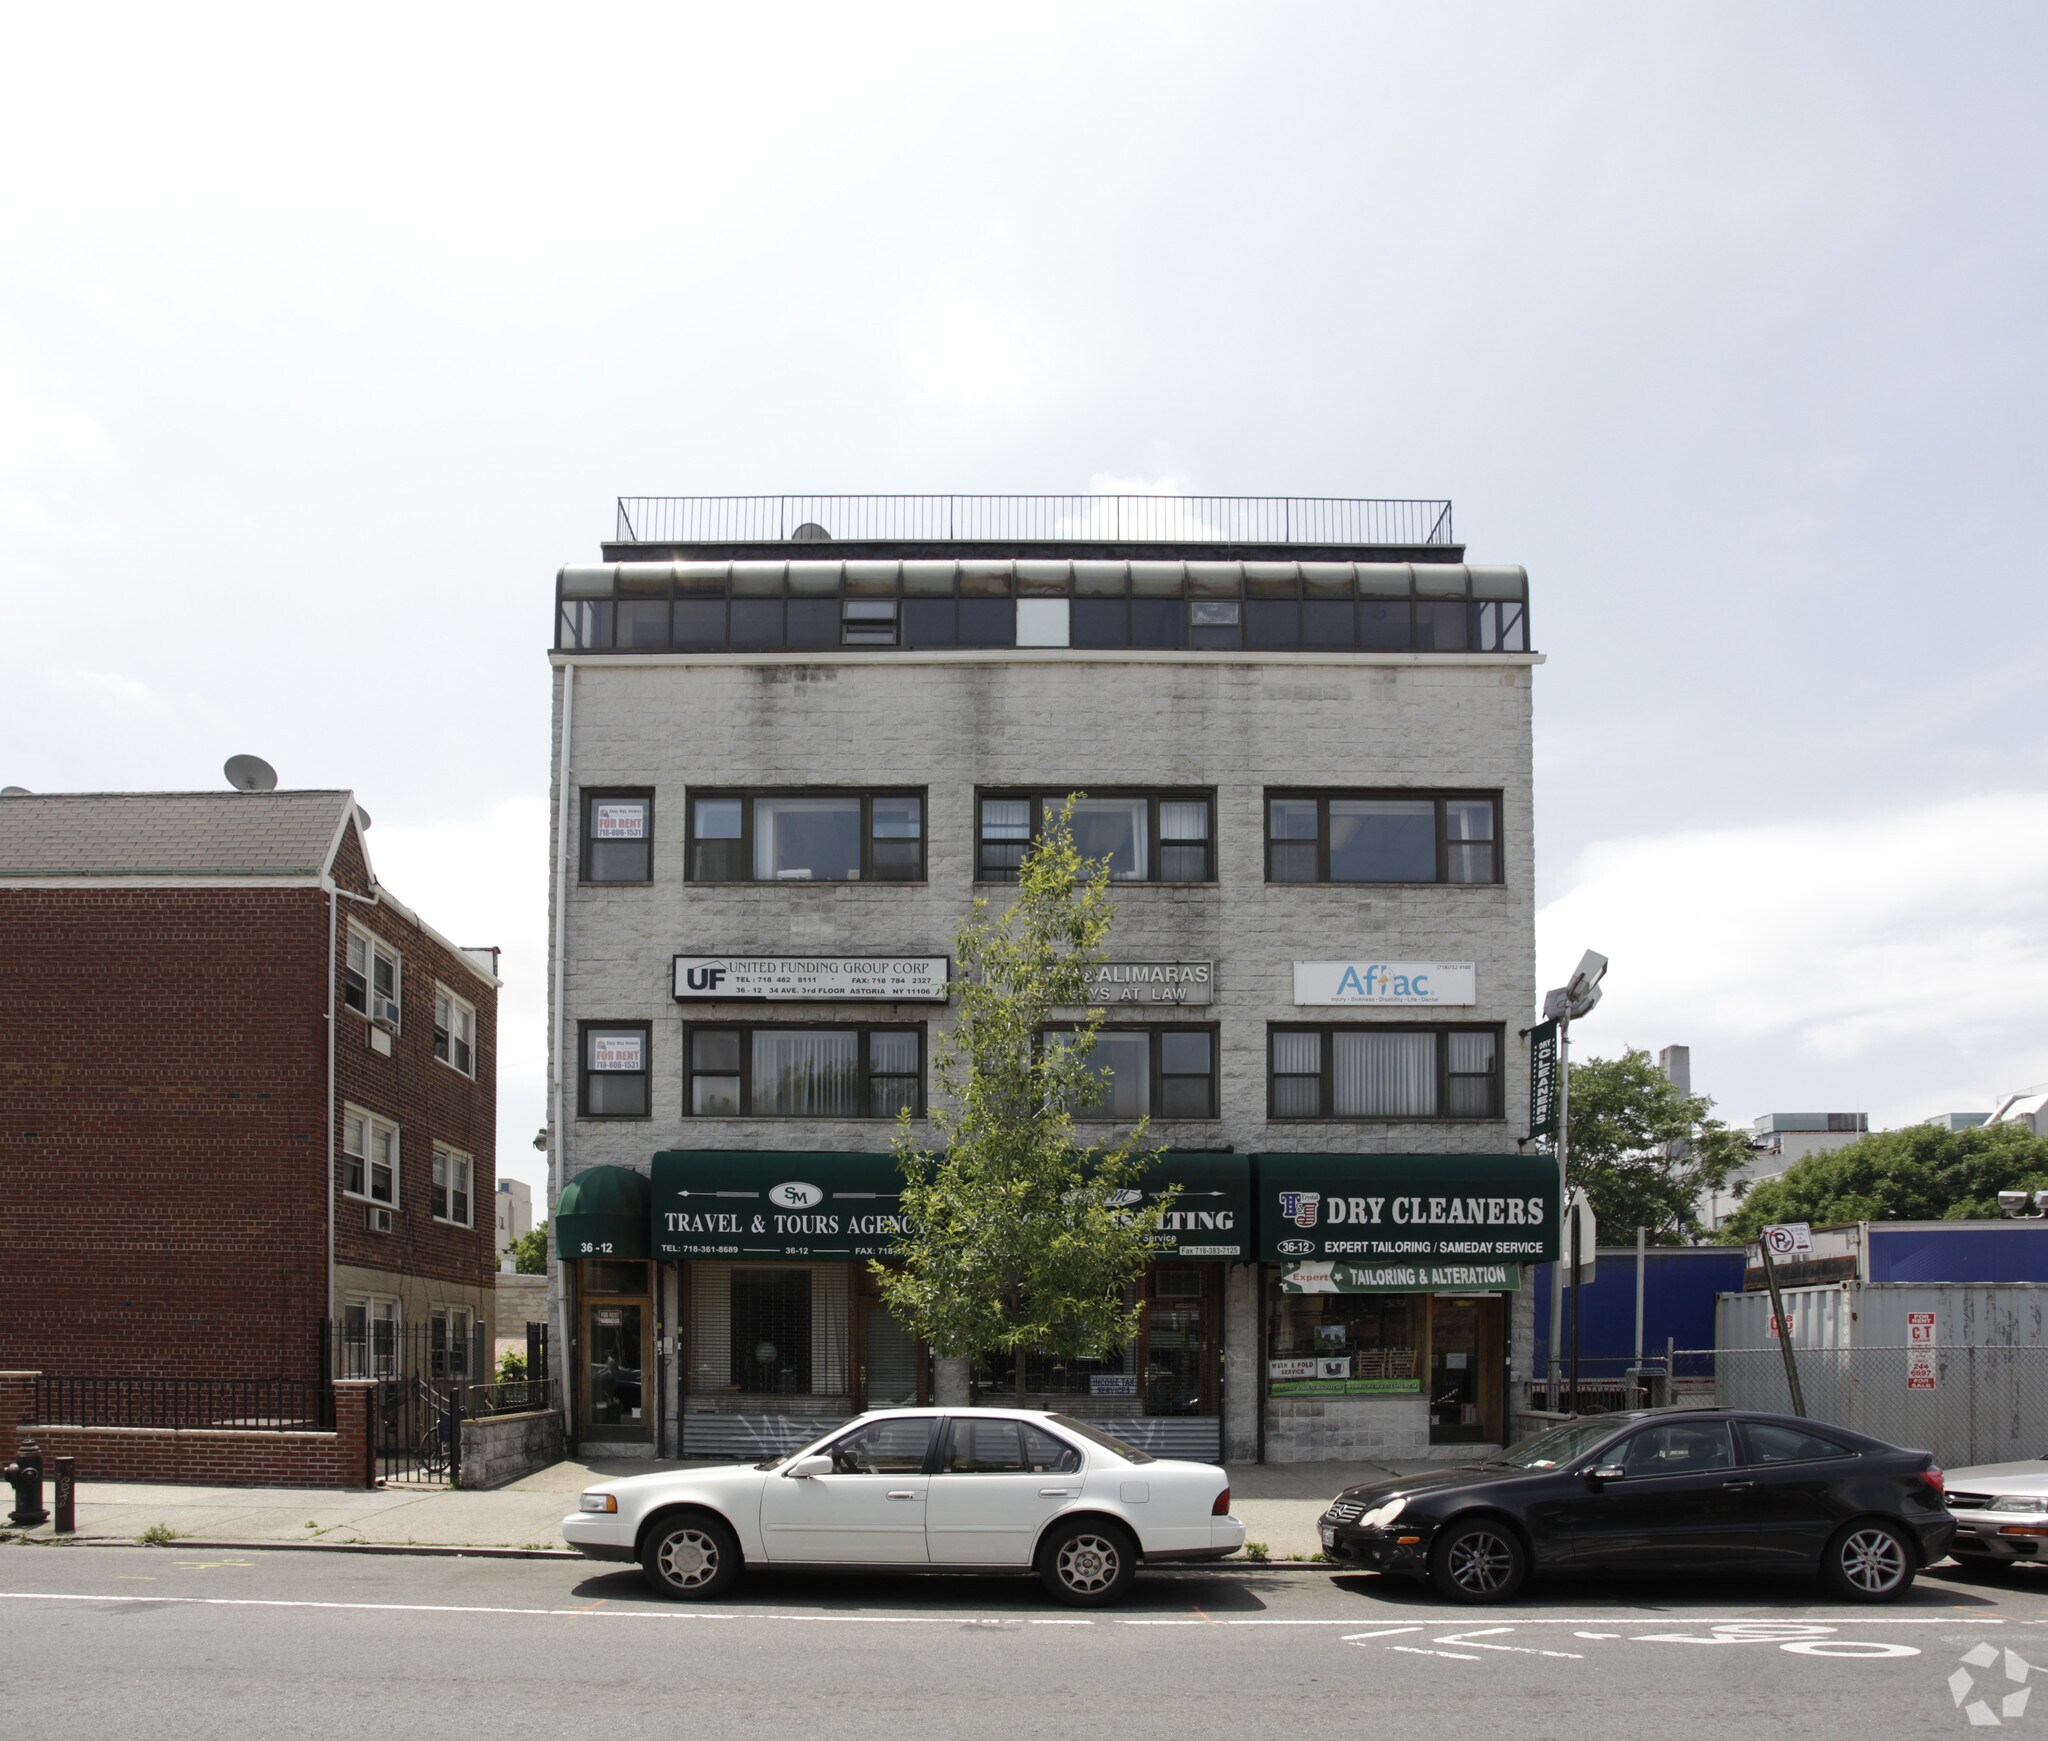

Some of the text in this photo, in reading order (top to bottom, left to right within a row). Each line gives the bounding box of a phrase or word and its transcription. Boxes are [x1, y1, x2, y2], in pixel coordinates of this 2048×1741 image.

[599, 818, 641, 828] FOR RENT
[729, 962, 929, 974] UNITED FUNDING GROUP CORP
[1099, 965, 1209, 983] ALIMARAS
[687, 968, 727, 990] UF
[1336, 964, 1429, 996] Aflac
[1121, 987, 1141, 1000] AT
[1152, 987, 1187, 1000] LAW
[1539, 1039, 1551, 1049] DRY
[597, 1051, 639, 1060] FOR RENT
[1535, 1049, 1551, 1125] CLEANERS
[1327, 1197, 1544, 1225] DRY CLEANERS
[664, 1213, 742, 1233] TRAVEL
[751, 1215, 766, 1233] &
[774, 1215, 839, 1234] TOURS
[1142, 1233, 1177, 1242] Service
[661, 1245, 739, 1253] TEL: 718-361-8689
[785, 1246, 809, 1254] 36-12
[855, 1247, 875, 1255] FAX:
[1282, 1242, 1310, 1252] 36-12
[1325, 1241, 1369, 1253] EXPERT
[1371, 1241, 1431, 1253] TAILORING
[1440, 1242, 1493, 1254] SAMEDAY
[1495, 1242, 1543, 1254] SERVICE
[1293, 1273, 1329, 1283] Expert
[1350, 1266, 1507, 1286] TAILORING & ALTERATION
